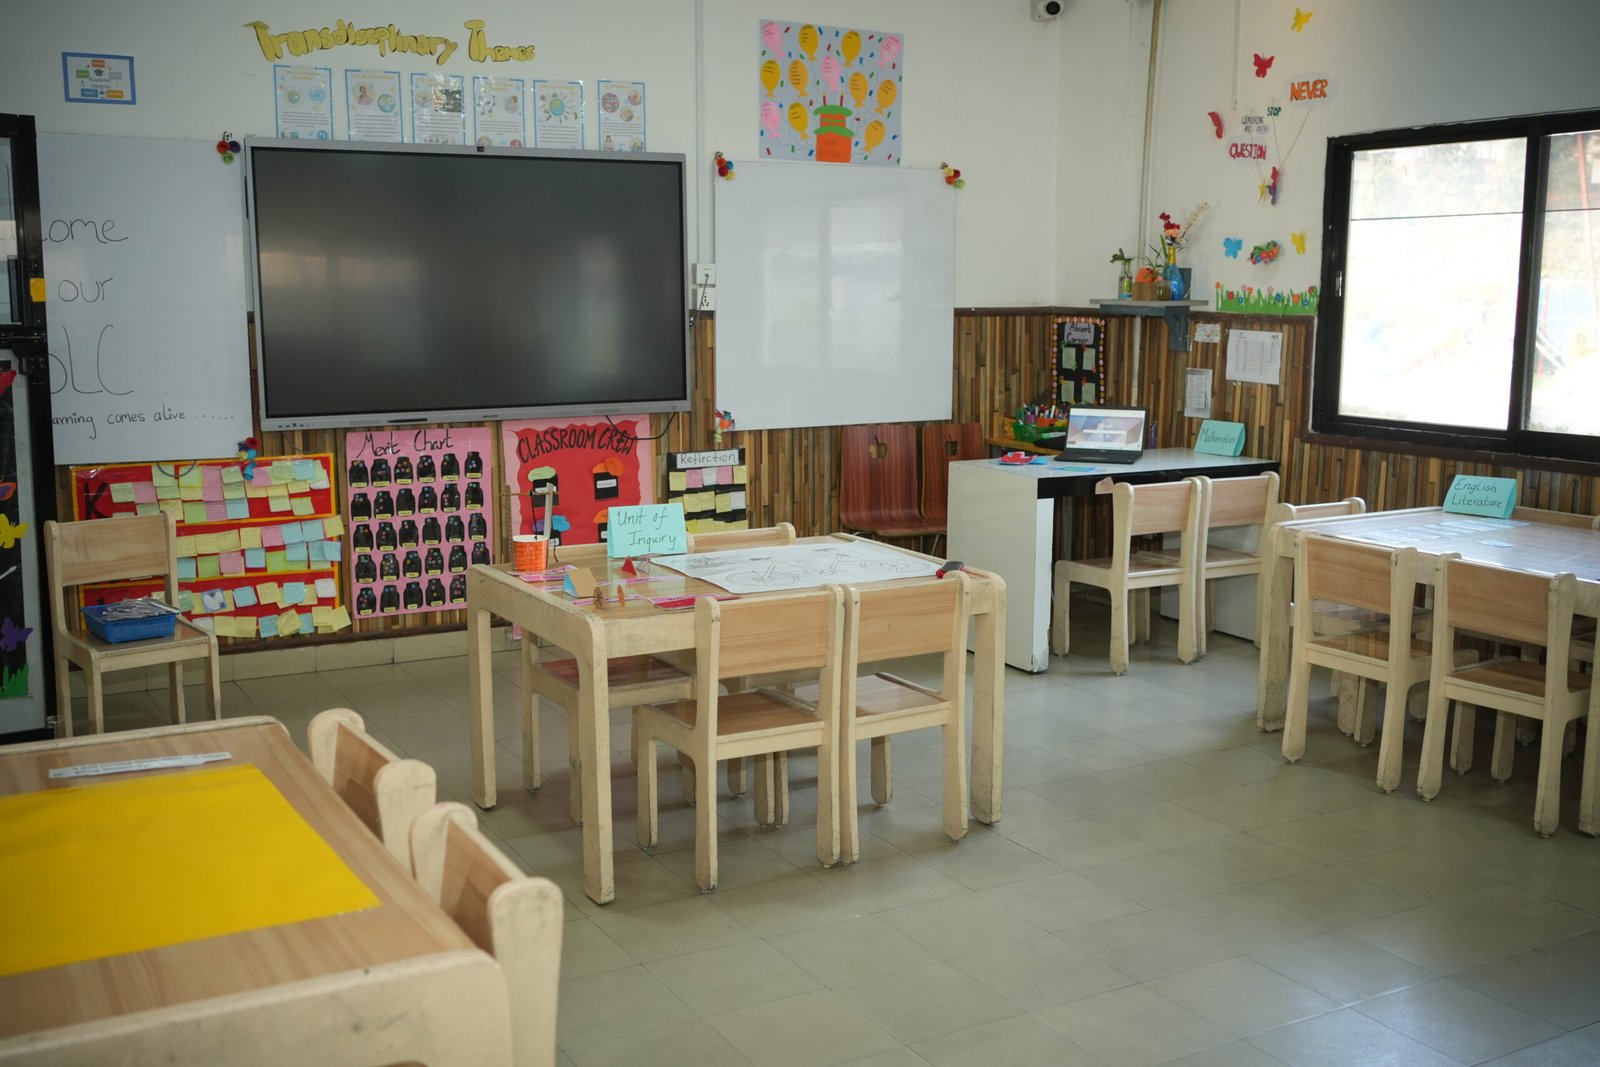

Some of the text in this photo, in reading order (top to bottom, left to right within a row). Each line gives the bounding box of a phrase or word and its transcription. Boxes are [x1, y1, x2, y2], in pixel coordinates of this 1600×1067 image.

[463, 19, 534, 62] Themes
[1290, 79, 1328, 101] NEVER
[1267, 106, 1281, 116] STOP
[1229, 143, 1267, 160] QUESTION
[42, 219, 128, 244] ome
[58, 277, 113, 303] our
[107, 412, 145, 425] comes
[355, 429, 453, 459] Merit Chart
[518, 427, 638, 463] CLASSROOM CREW
[680, 453, 737, 465] Reflection
[1454, 478, 1498, 498] English
[83, 481, 112, 520] K
[1451, 492, 1503, 509] Literature
[617, 507, 669, 530] Unit of
[628, 530, 677, 552] Inquiry
